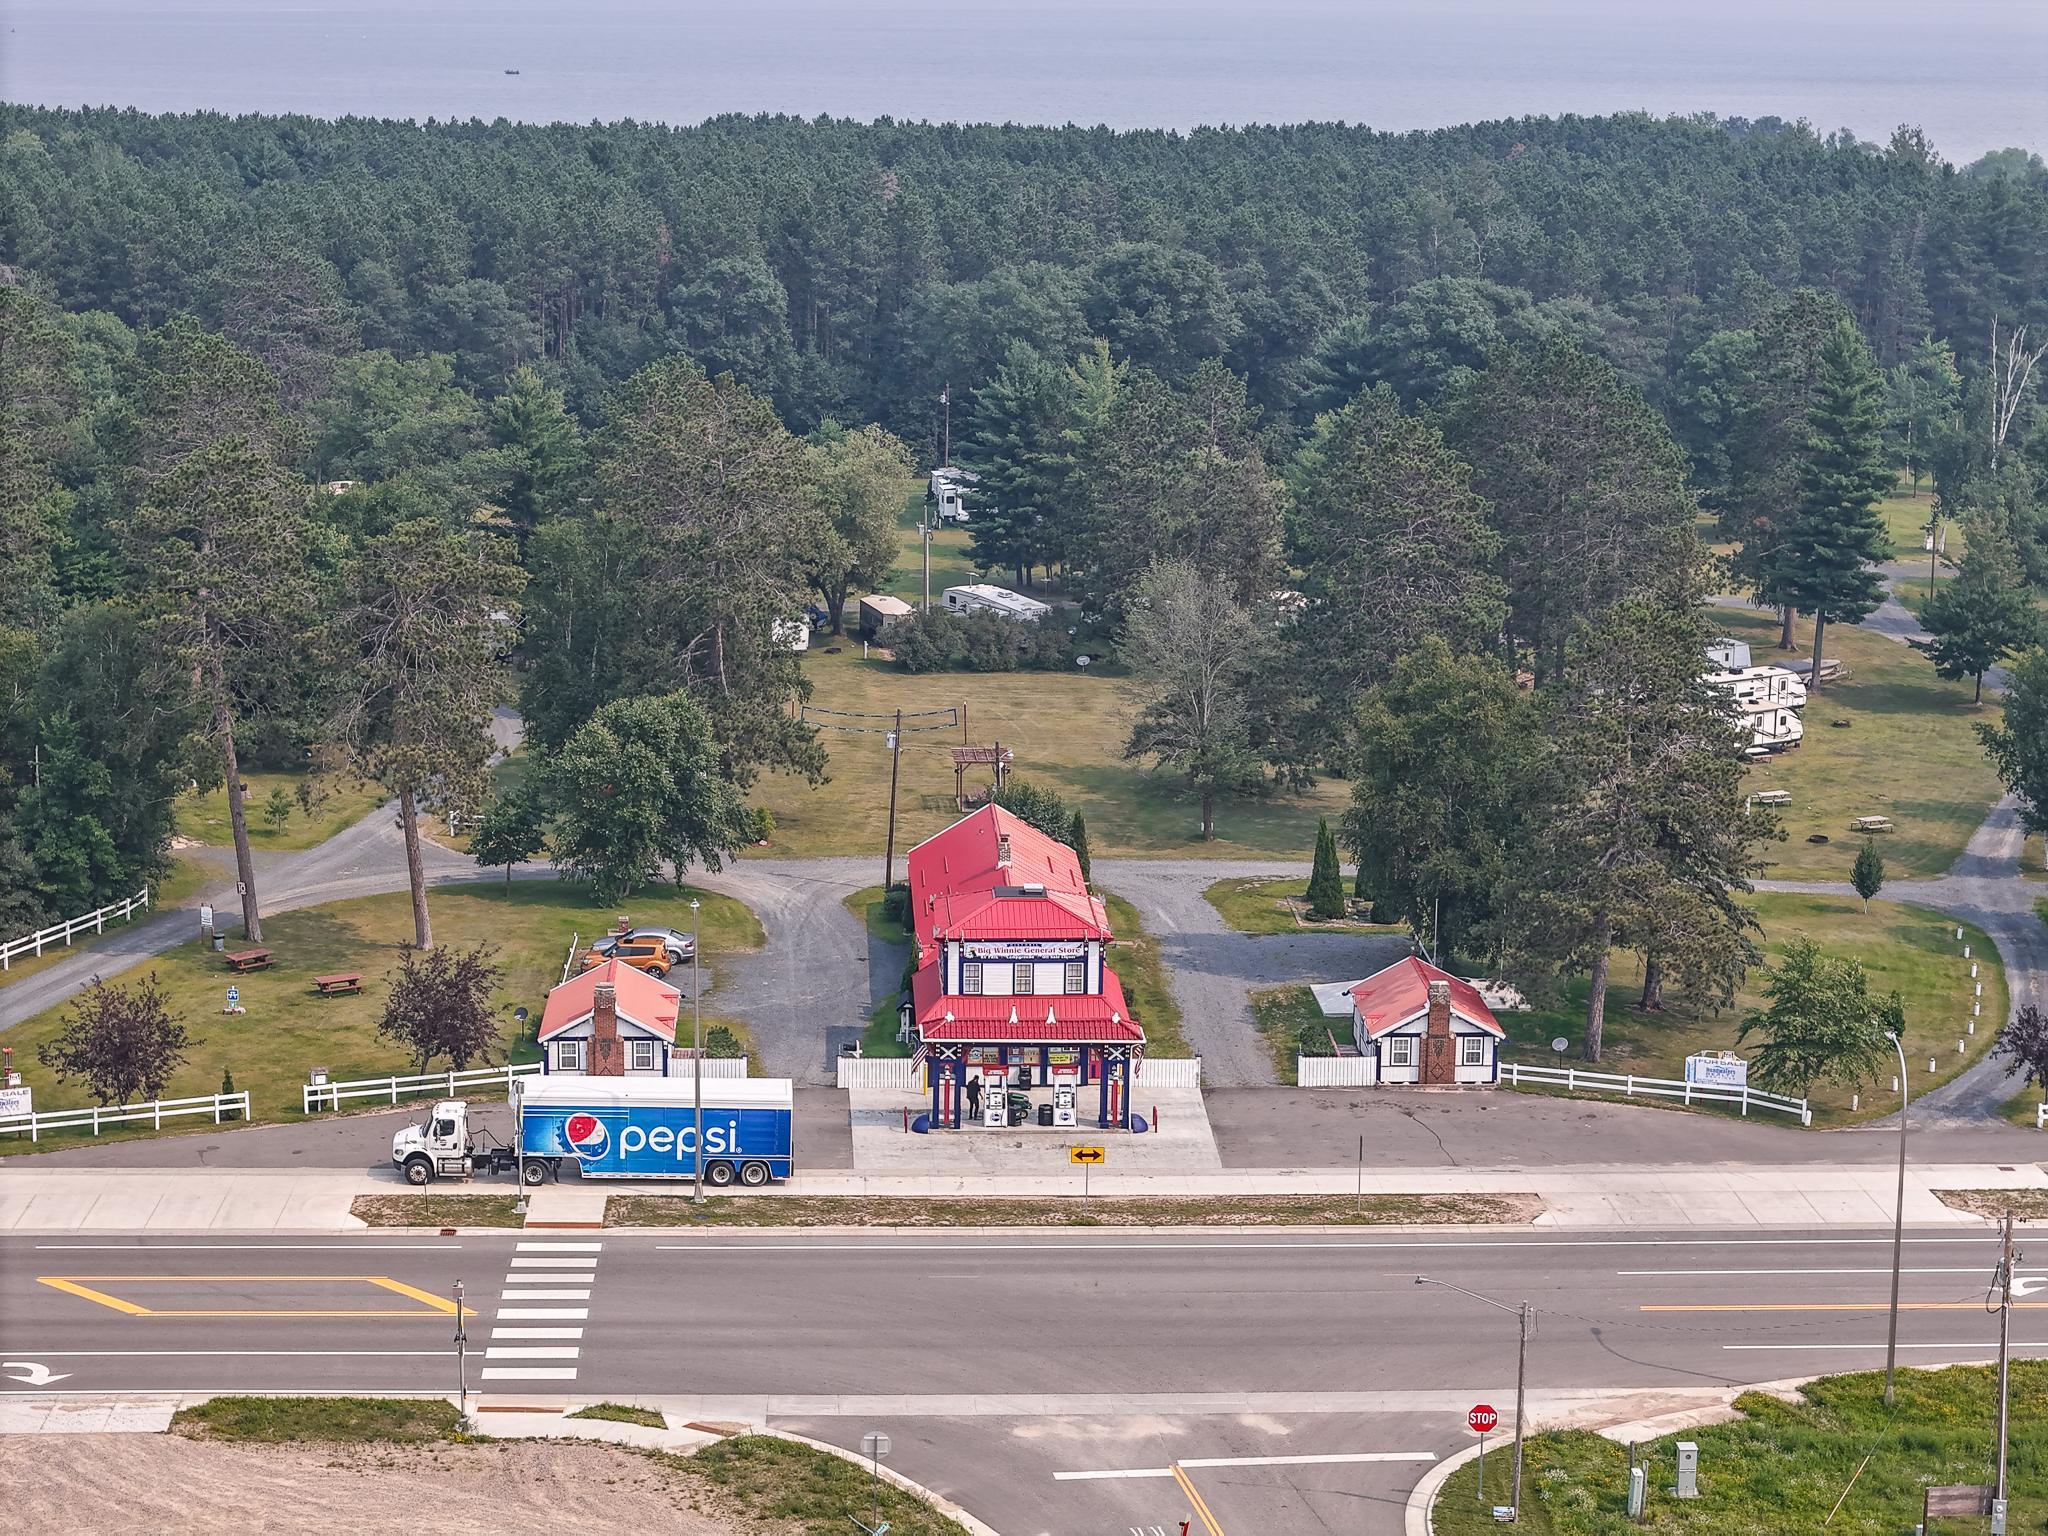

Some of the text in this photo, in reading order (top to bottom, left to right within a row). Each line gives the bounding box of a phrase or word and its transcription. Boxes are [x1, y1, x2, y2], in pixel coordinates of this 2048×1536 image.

[977, 947, 991, 955] Big
[1, 1089, 29, 1098] SALE
[620, 1120, 736, 1160] pepsi
[1469, 1412, 1497, 1425] STOP
